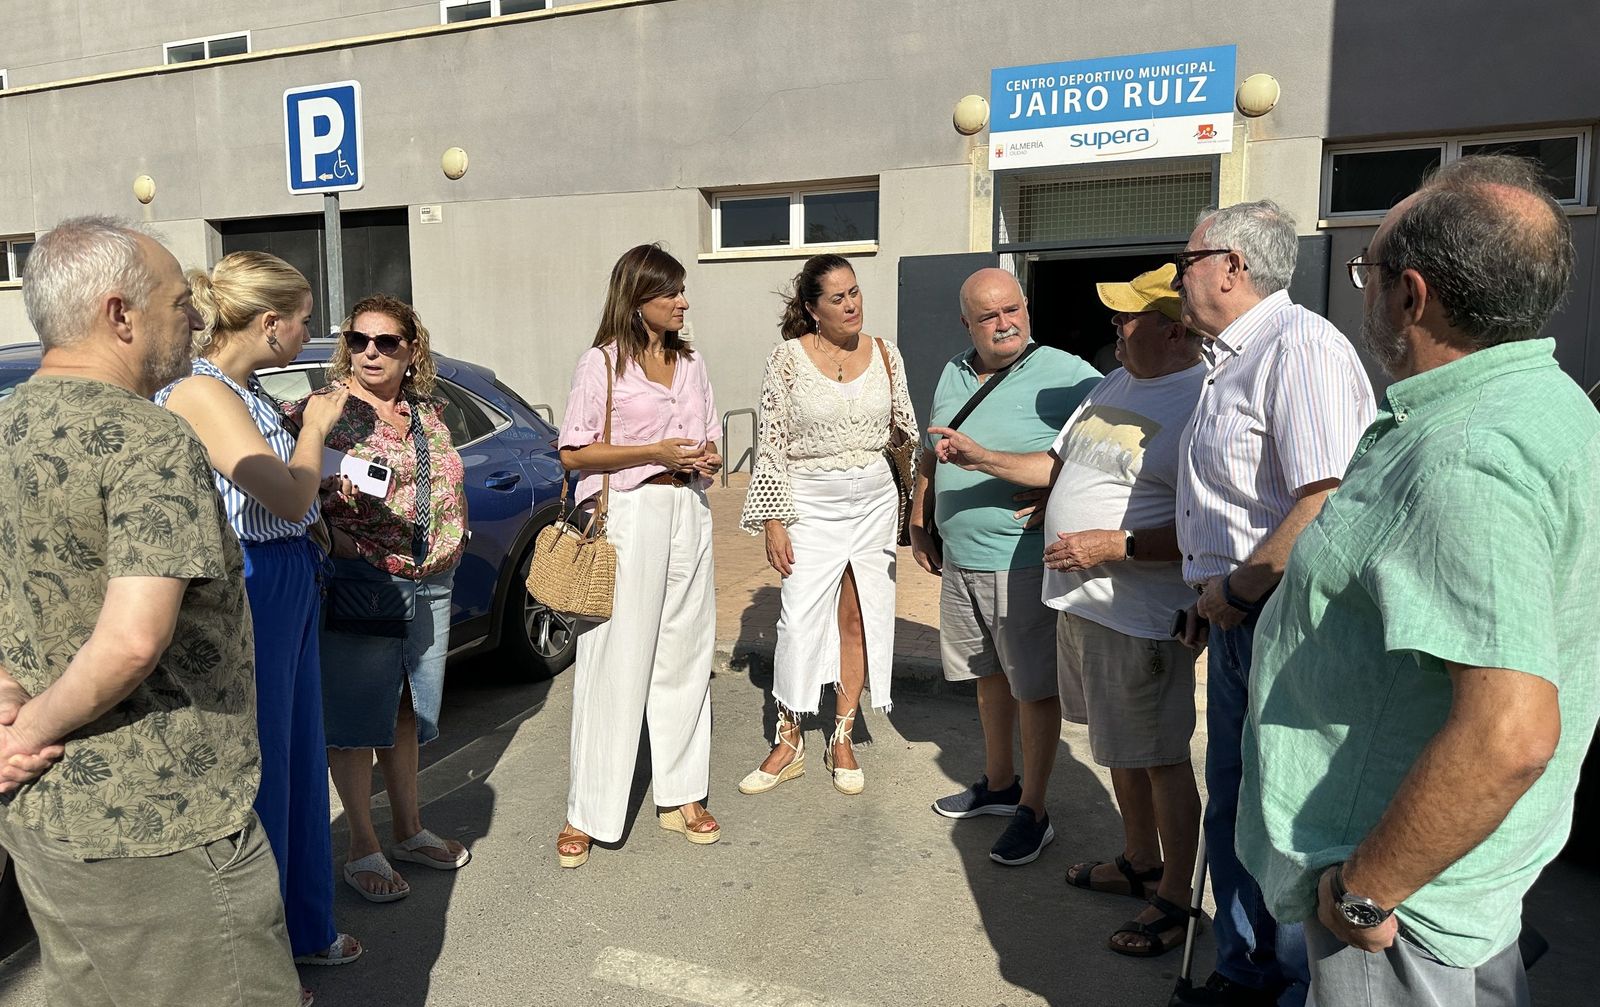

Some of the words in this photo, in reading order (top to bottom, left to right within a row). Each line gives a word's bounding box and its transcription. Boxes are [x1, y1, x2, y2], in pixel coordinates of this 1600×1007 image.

[1006, 77, 1055, 92] CENTRO
[1060, 69, 1134, 86] DEPORTIVO
[1139, 61, 1216, 79] MUNICIPAL
[1009, 85, 1109, 119] JAIRO
[1124, 76, 1207, 108] RUIZ
[298, 97, 345, 182] P
[1010, 141, 1044, 150] ALMERÍA
[1070, 127, 1149, 149] supera
